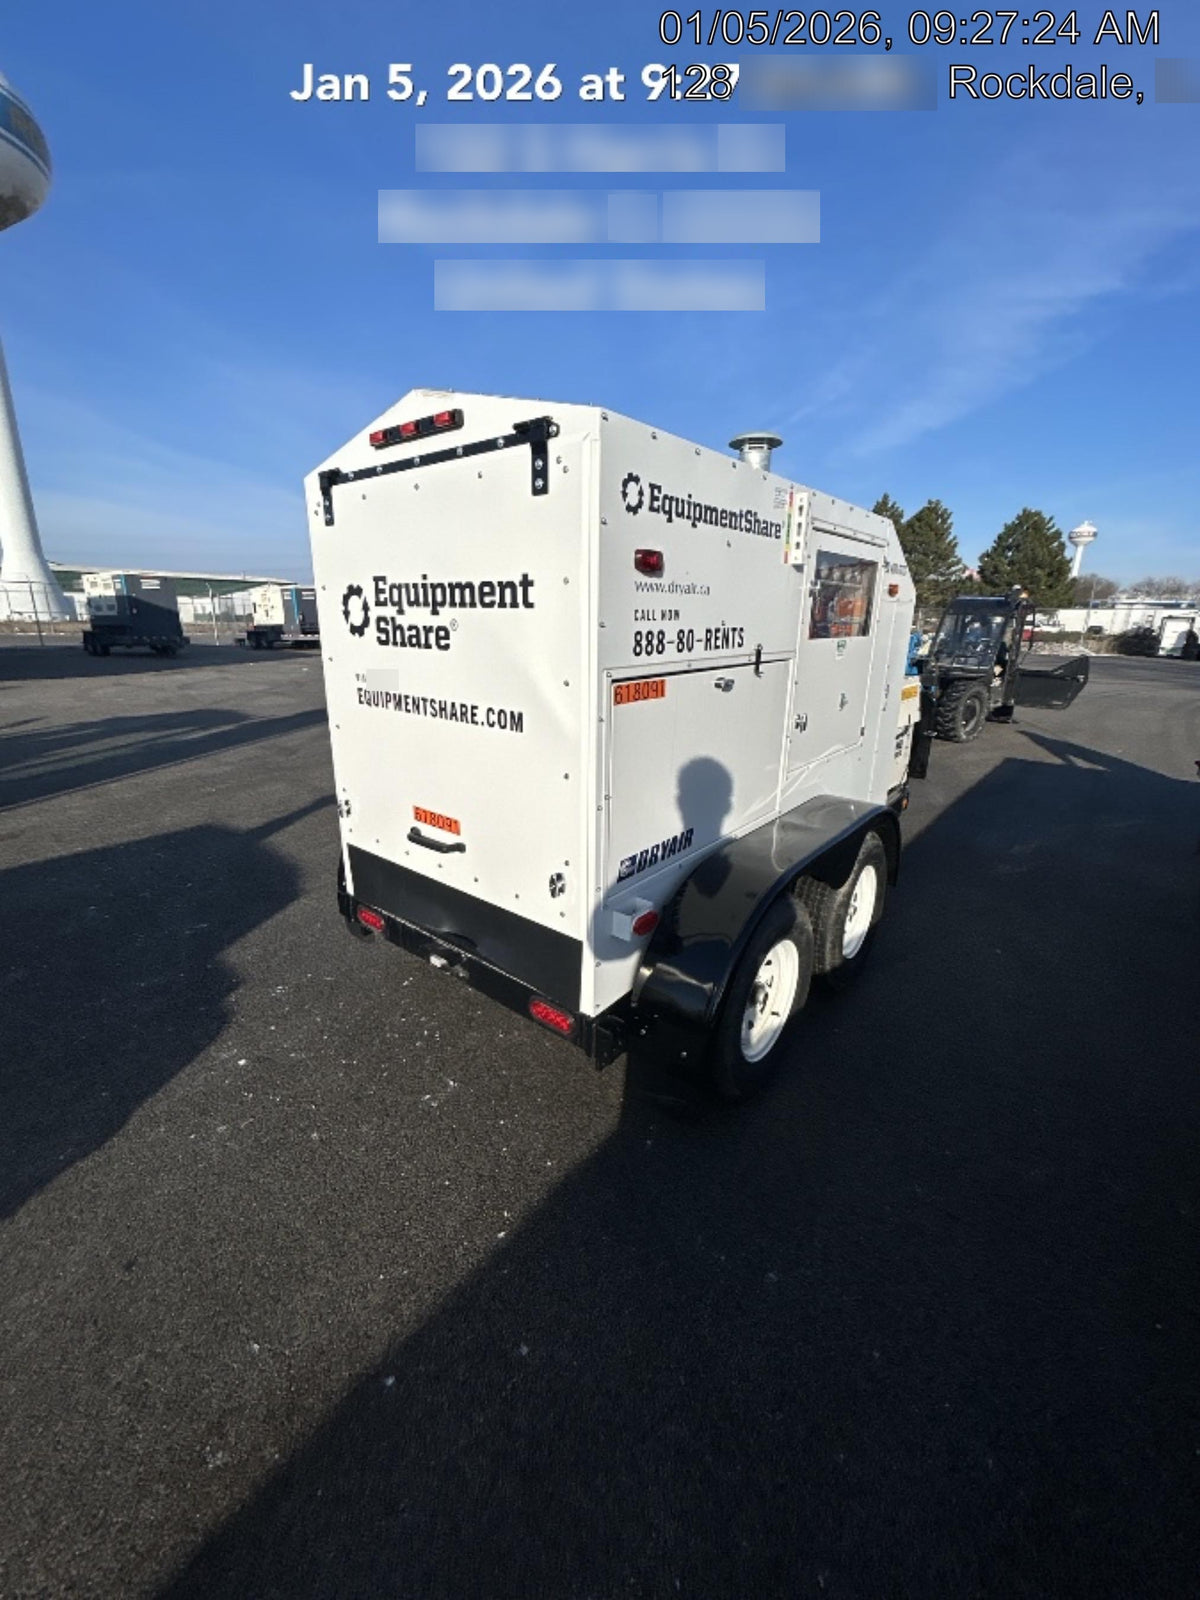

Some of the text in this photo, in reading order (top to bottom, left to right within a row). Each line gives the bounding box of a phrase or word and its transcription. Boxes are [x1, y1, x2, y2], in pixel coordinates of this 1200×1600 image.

[648, 482, 782, 539] EquipmentShare
[373, 573, 535, 616] Equipment
[634, 609, 657, 621] CALL
[376, 616, 451, 651] Share
[633, 627, 744, 656] 888-80-RENTS
[614, 680, 665, 705] 618091
[356, 688, 524, 733] EQUIPMENTSHARE.COM
[414, 806, 460, 835] 618091
[636, 828, 694, 874] DRYAIR
